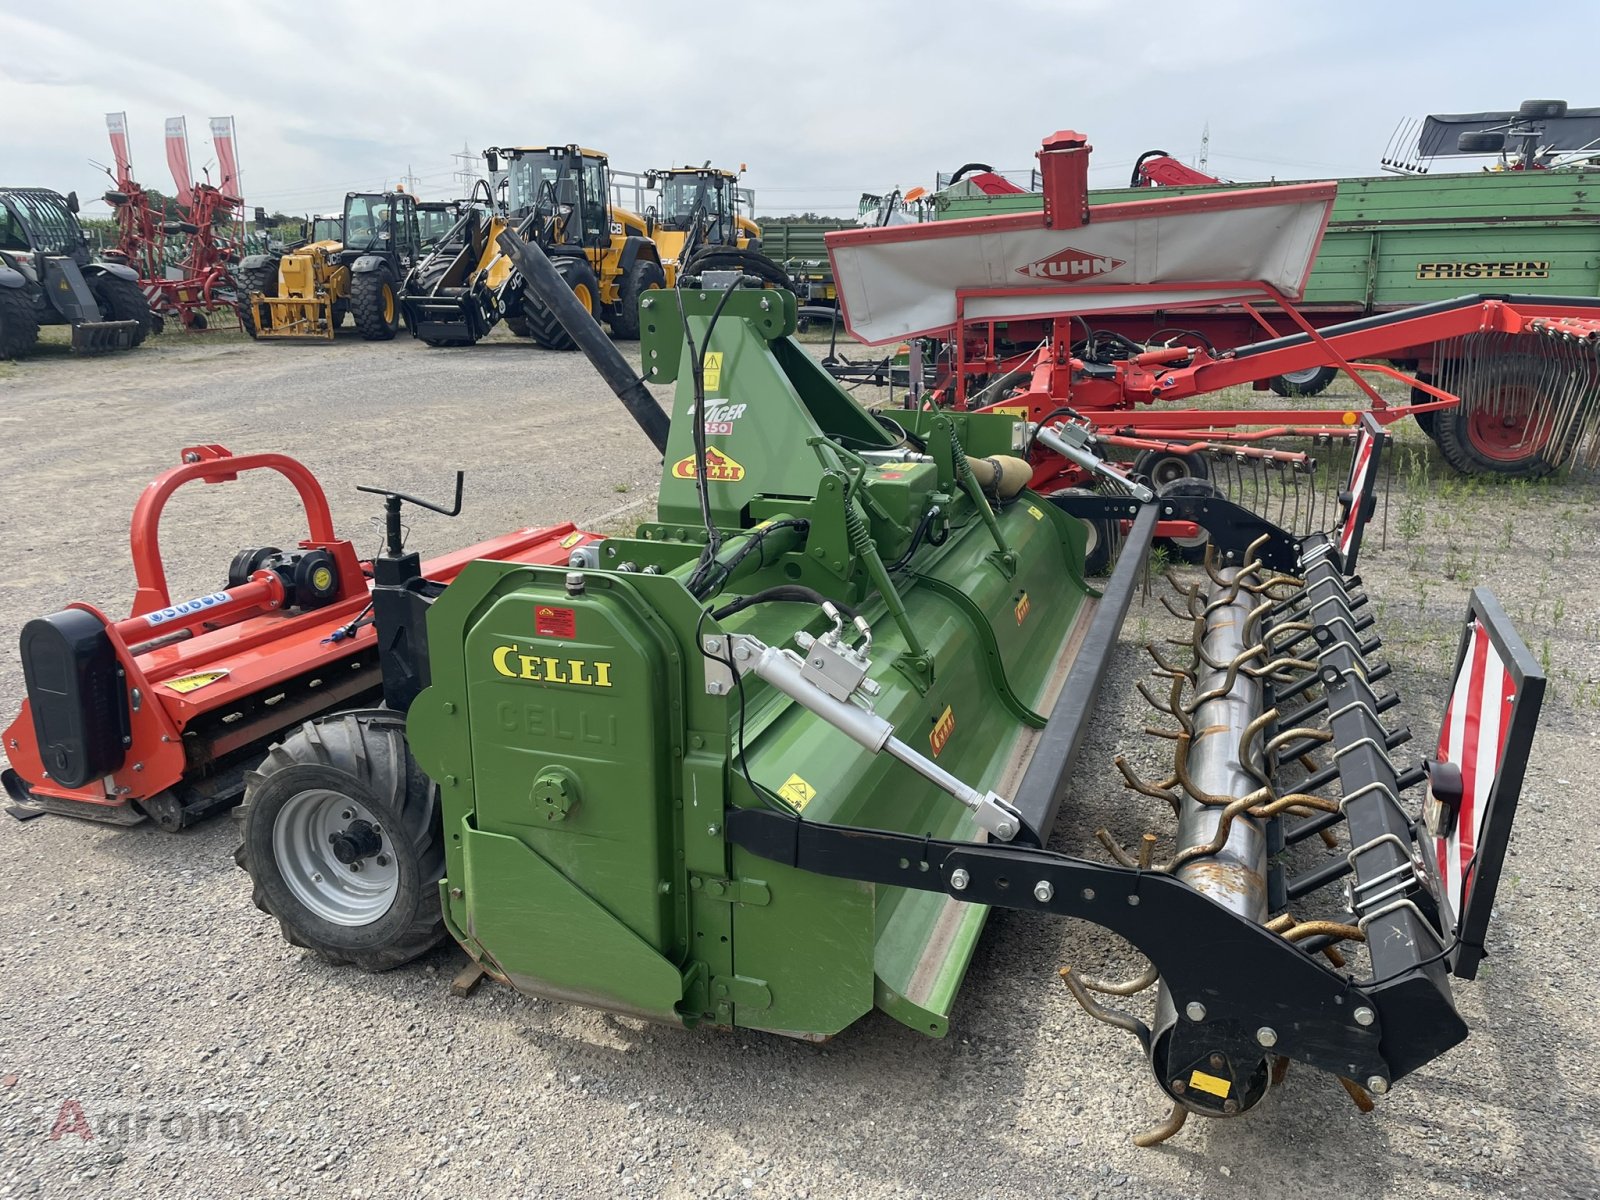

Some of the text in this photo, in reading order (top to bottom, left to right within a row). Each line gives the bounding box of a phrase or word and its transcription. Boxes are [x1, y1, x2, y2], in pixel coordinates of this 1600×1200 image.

[327, 252, 342, 266] JCB
[1028, 258, 1112, 277] KUHN
[1420, 262, 1546, 278] FRISTEIN
[677, 460, 742, 480] CLLI
[491, 643, 614, 689] CELLI
[497, 700, 619, 746] CELLI
